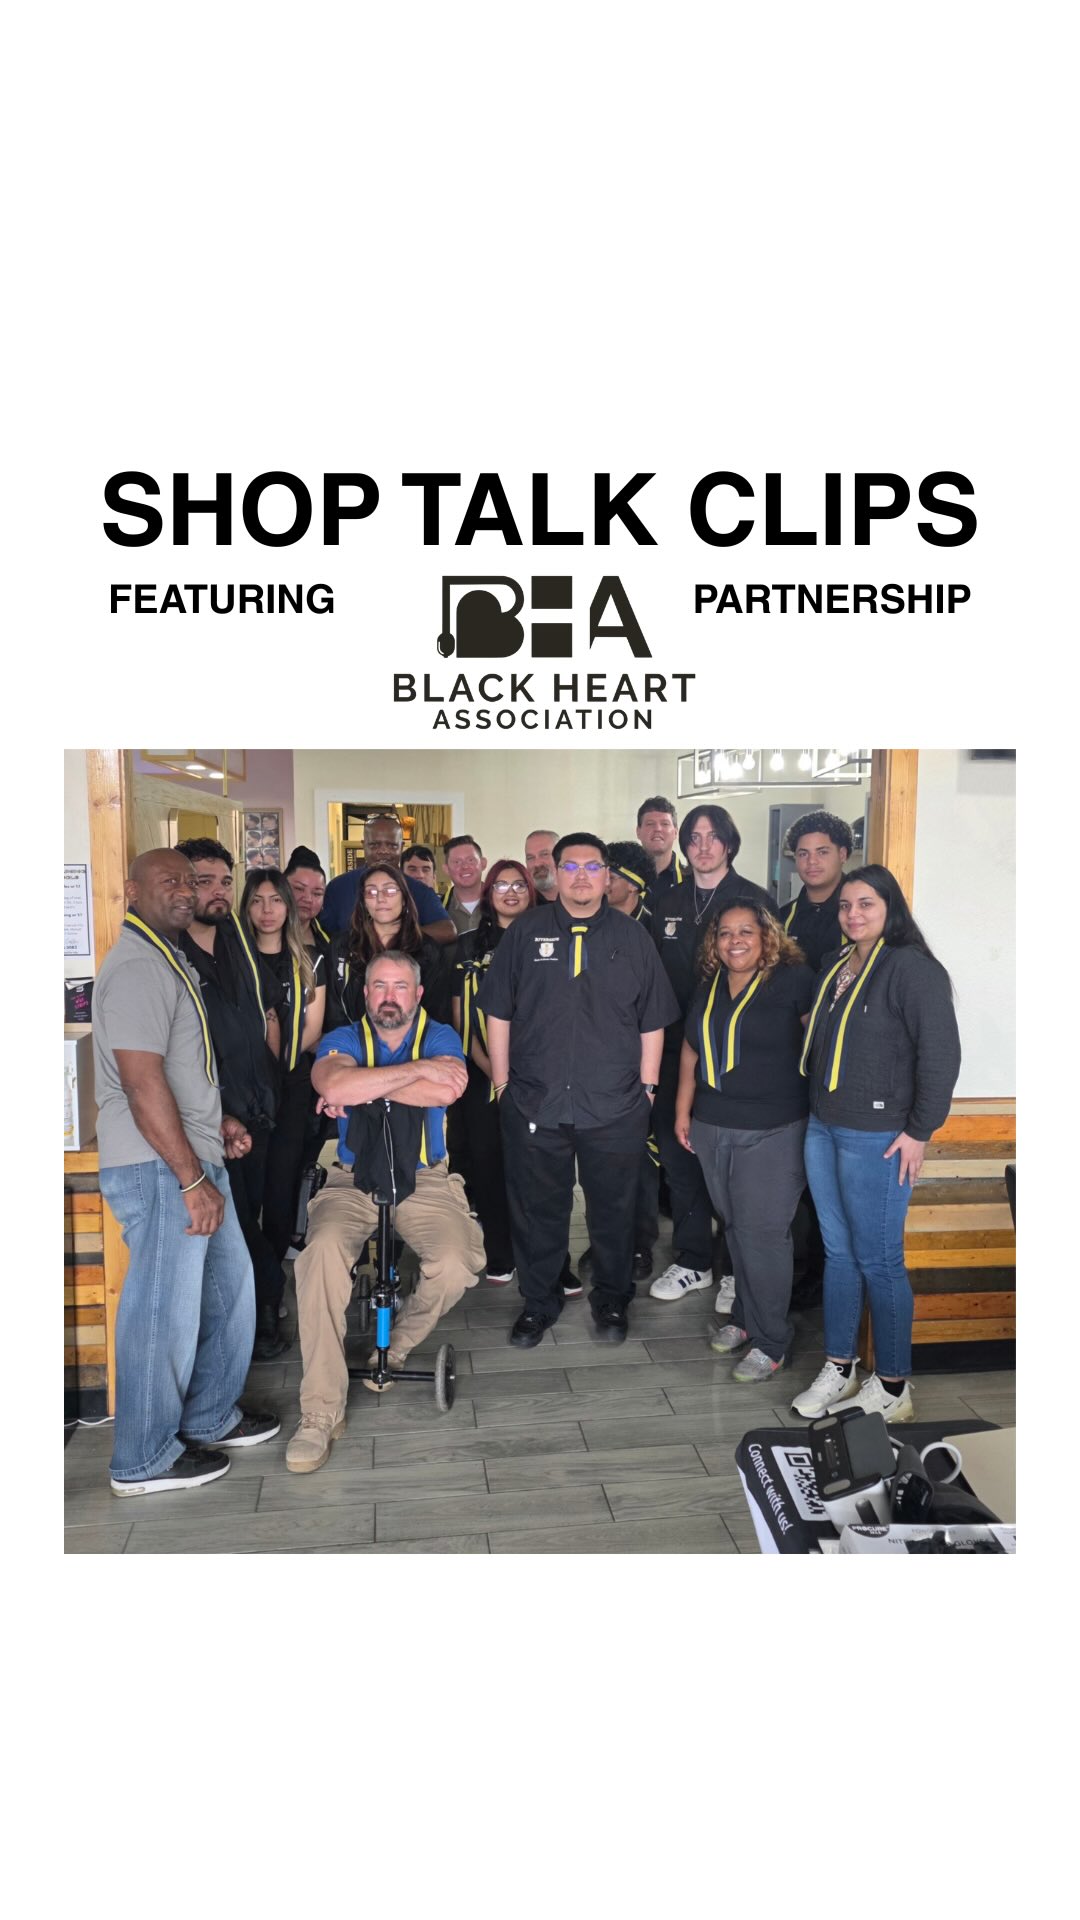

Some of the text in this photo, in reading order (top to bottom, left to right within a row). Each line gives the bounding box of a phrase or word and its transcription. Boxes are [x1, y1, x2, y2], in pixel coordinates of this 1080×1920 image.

[346, 848, 354, 872] RSIDE
[748, 1443, 794, 1535] Connect with us!
